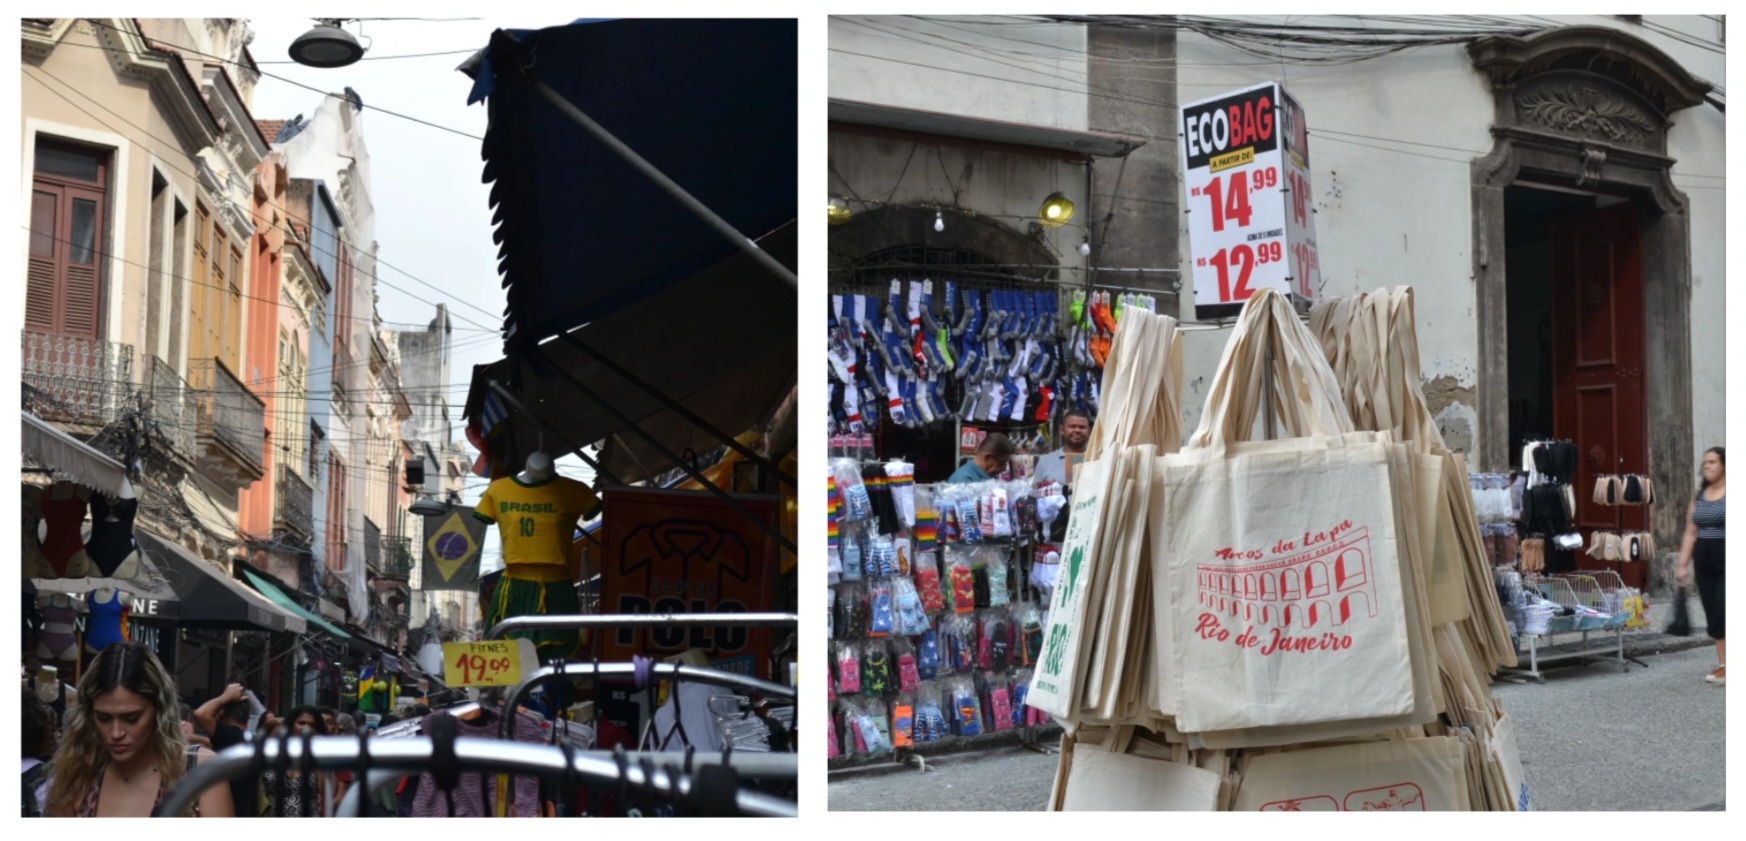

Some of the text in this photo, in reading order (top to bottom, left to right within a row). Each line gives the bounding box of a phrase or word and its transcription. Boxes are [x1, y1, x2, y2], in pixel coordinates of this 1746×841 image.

[1186, 96, 1273, 157] ECOBAG
[1218, 155, 1240, 166] PARTIR
[1203, 166, 1278, 232] 14,99
[1209, 241, 1282, 303] 12,99
[500, 501, 559, 514] BRASIL
[520, 517, 535, 537] 10
[1214, 519, 1352, 561] Arcos da Lapa
[651, 578, 717, 596] CAMISA
[617, 594, 748, 652] POLO
[1195, 612, 1353, 656] Rio de Janeiro
[470, 643, 508, 653] FITNES
